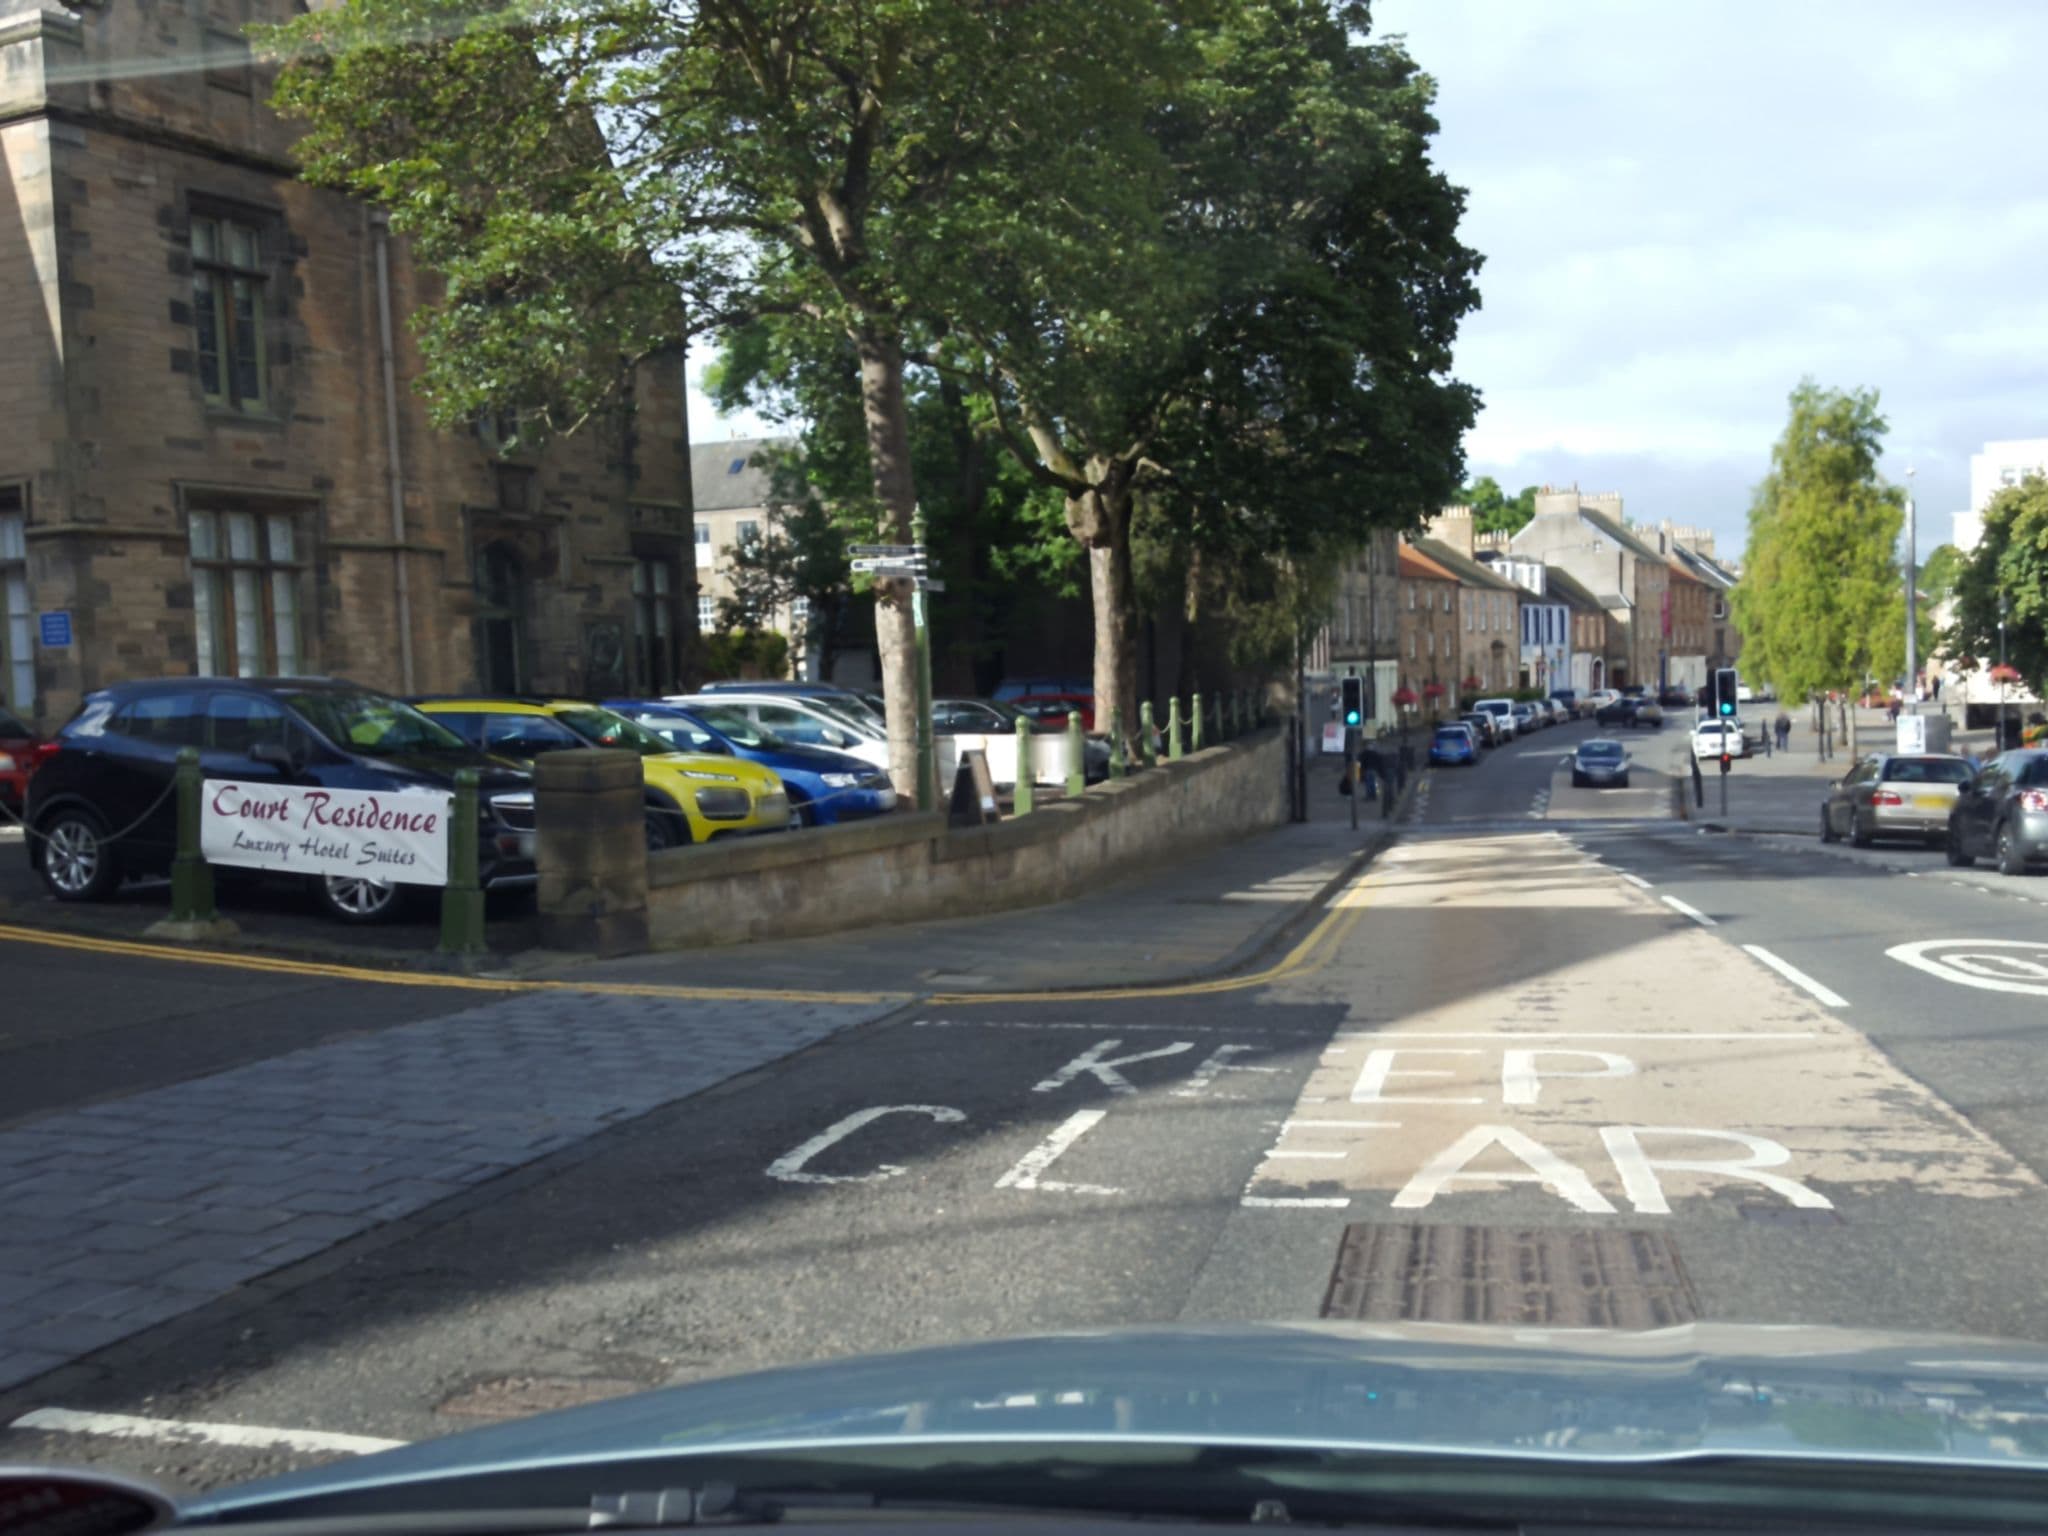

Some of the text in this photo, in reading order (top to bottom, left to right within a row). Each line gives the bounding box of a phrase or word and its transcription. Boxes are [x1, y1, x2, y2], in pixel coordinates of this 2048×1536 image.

[212, 785, 438, 834] Court Residence
[232, 830, 416, 865] Luxury Hotel Suites
[1032, 1039, 1637, 1104] KEEP
[764, 1105, 1836, 1215] CLEAR
